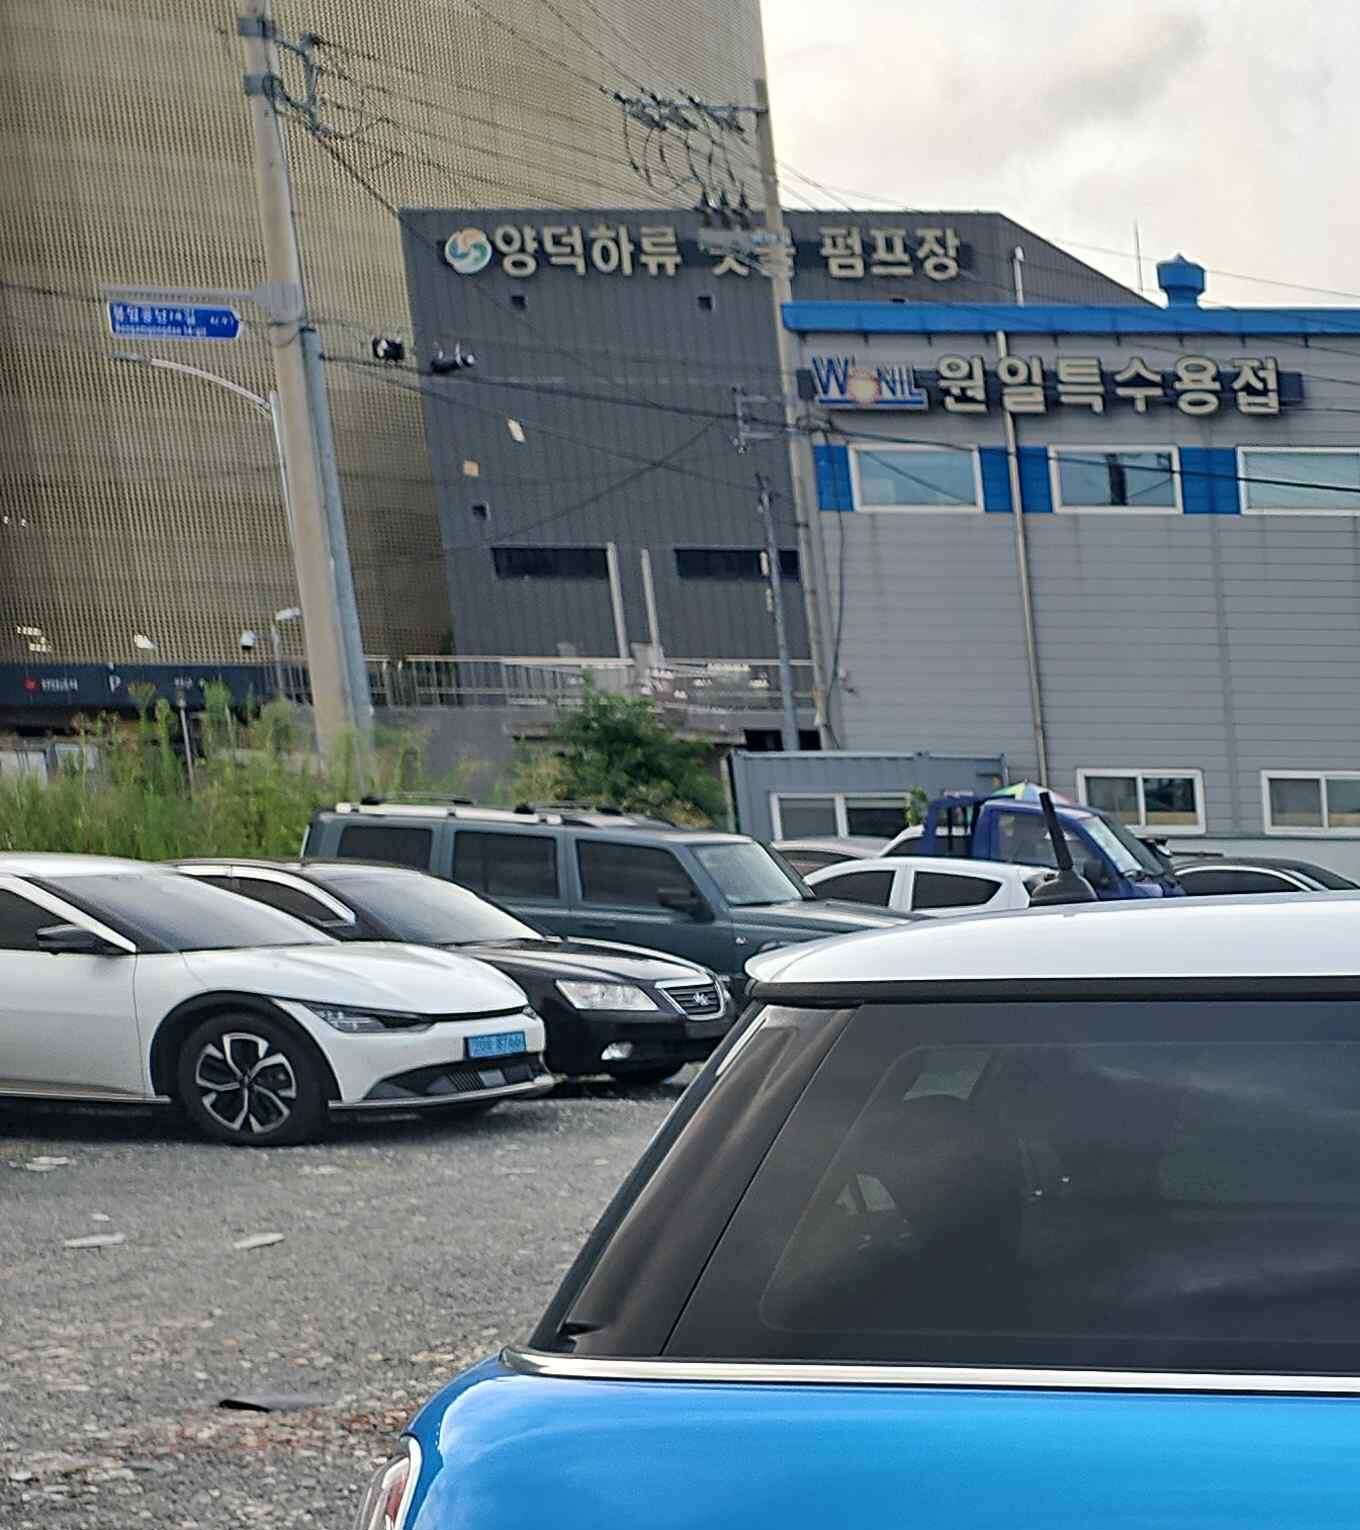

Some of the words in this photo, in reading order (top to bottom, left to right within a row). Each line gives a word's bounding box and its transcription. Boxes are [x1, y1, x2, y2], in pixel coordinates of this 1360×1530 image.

[494, 224, 683, 278] 양덕하류
[820, 226, 960, 280] 펌프장
[937, 353, 1281, 415] 원일특수용접
